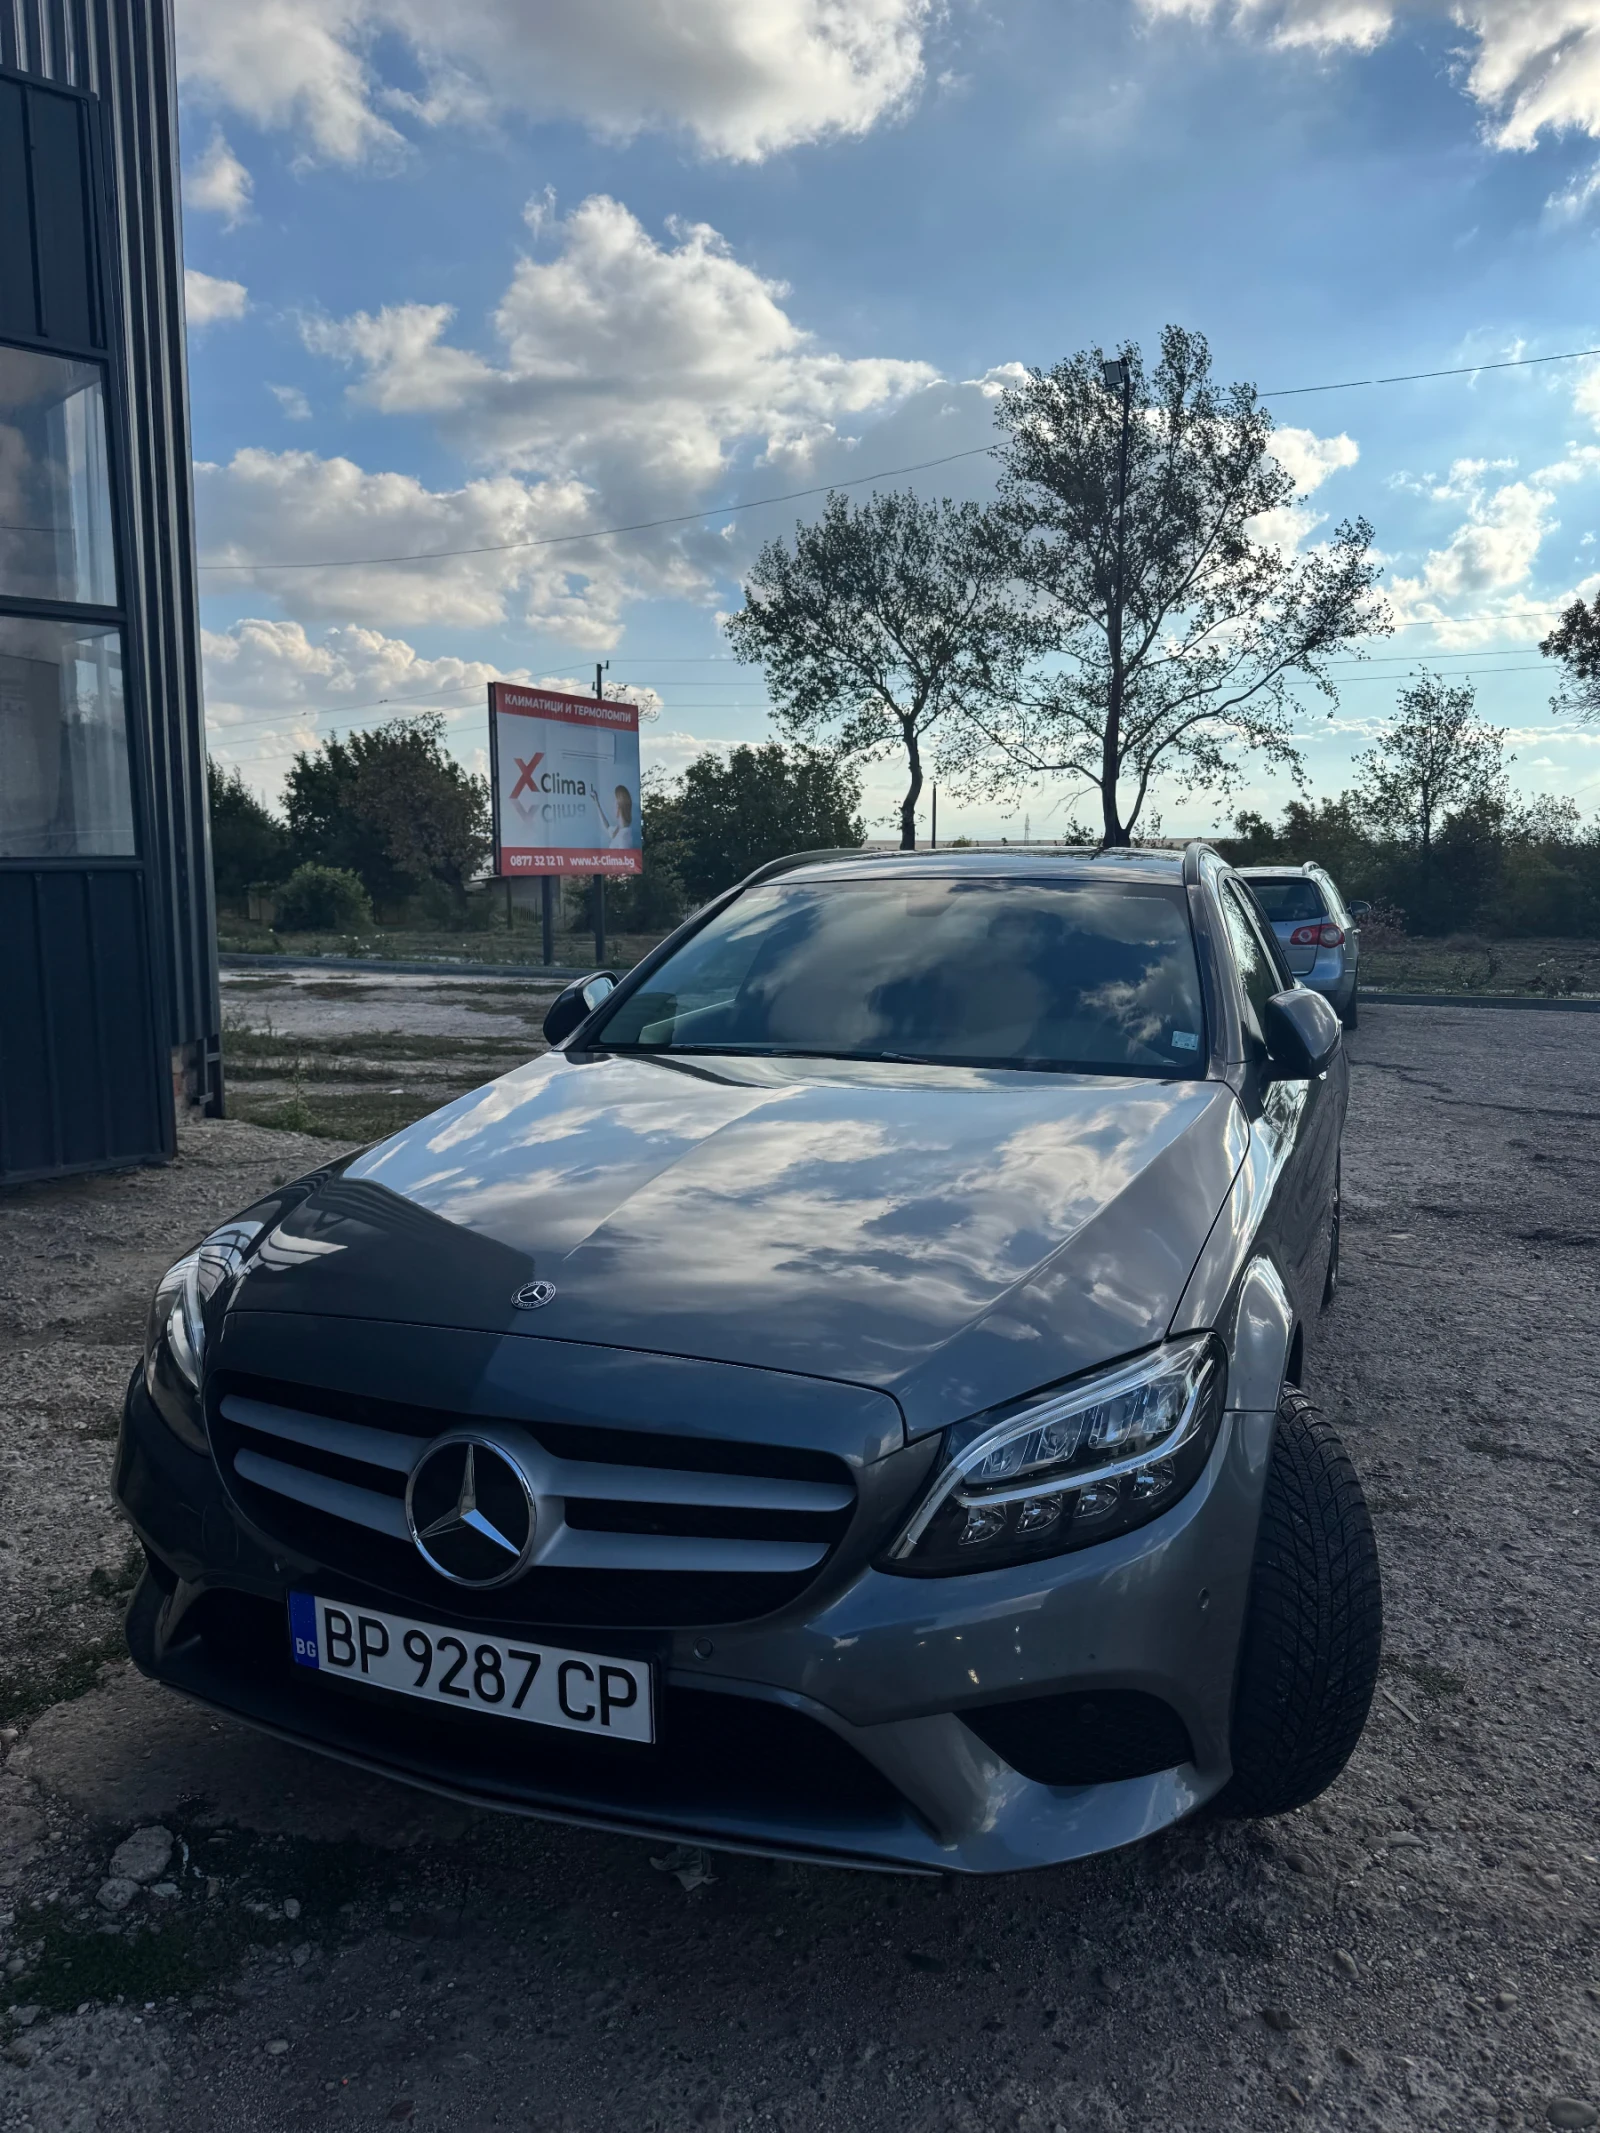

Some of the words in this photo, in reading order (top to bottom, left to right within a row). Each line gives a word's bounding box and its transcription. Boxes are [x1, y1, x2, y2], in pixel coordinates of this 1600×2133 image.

[505, 694, 564, 714] КЛИМАТИЦИ
[565, 704, 572, 714] И
[574, 705, 631, 723] ТЕРМОПОМПИ
[510, 855, 532, 867] 0877
[534, 855, 545, 867] 32
[546, 855, 555, 867] 12
[556, 855, 564, 867] 11
[570, 854, 635, 868] www.X-Clima.bg
[296, 1637, 316, 1657] BG
[324, 1607, 389, 1673] BP
[403, 1629, 541, 1709] 9287
[557, 1659, 637, 1726] CP
